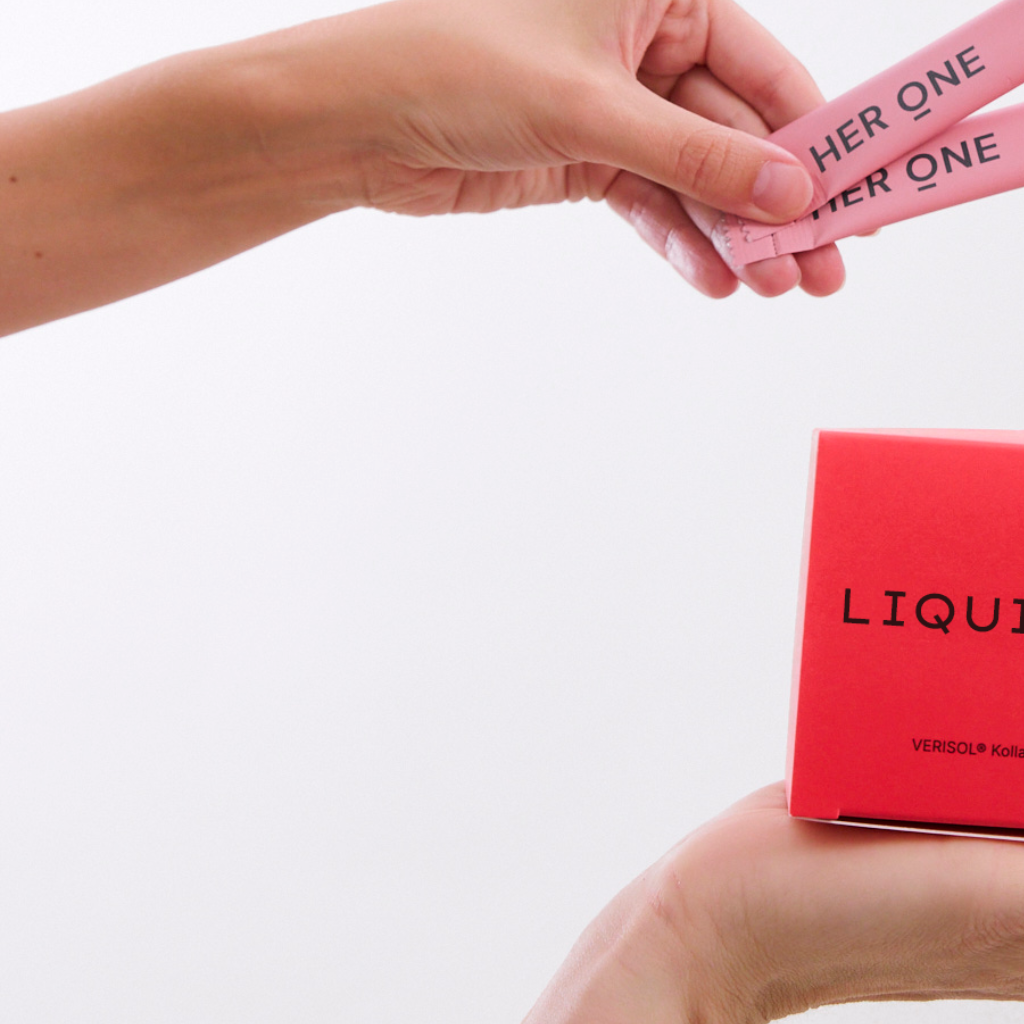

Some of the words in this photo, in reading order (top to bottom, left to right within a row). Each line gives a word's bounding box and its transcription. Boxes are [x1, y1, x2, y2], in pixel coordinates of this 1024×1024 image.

[809, 105, 890, 173] HER
[897, 45, 986, 122] ONE
[906, 132, 1001, 191] ONE
